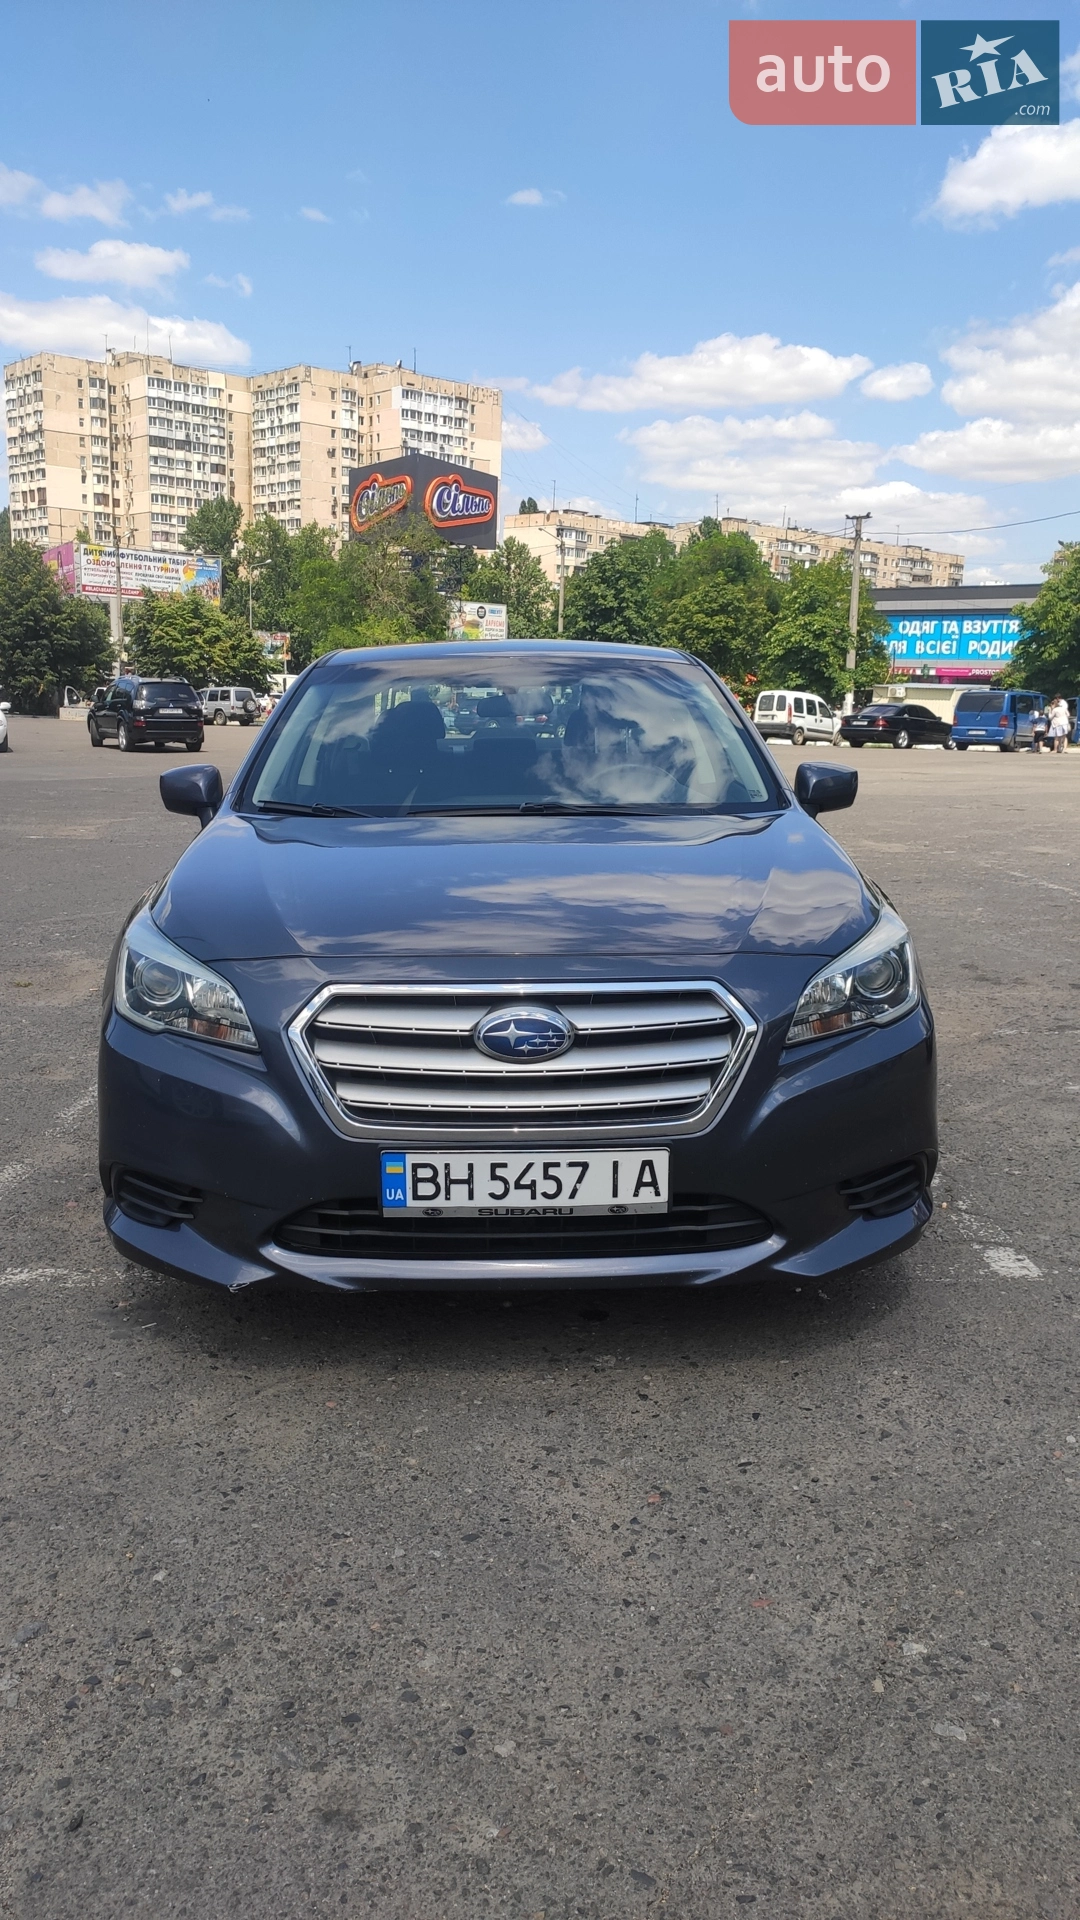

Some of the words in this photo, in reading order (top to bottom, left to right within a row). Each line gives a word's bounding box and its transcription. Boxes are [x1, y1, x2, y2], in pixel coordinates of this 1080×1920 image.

[433, 483, 492, 518] Сільпо
[86, 558, 142, 570] ОЗДОРОЛЕННЯ
[153, 565, 180, 574] ТУРНІРИ
[119, 552, 167, 563] ФУТБОЛЬНИЙ
[168, 557, 187, 566] ТАБІР
[898, 620, 938, 636] ОДЯГ
[942, 620, 959, 634] ТА
[963, 619, 1019, 634] ВЗУТТЯ
[883, 640, 907, 654] ЛЯ
[915, 635, 958, 655] ВСІЄЇ
[968, 640, 1018, 658] РОДИ
[411, 1161, 474, 1201] BH
[487, 1161, 589, 1201] 5457
[612, 1159, 661, 1198] IA
[386, 1188, 404, 1201] UA
[477, 1207, 574, 1217] SUBARU
